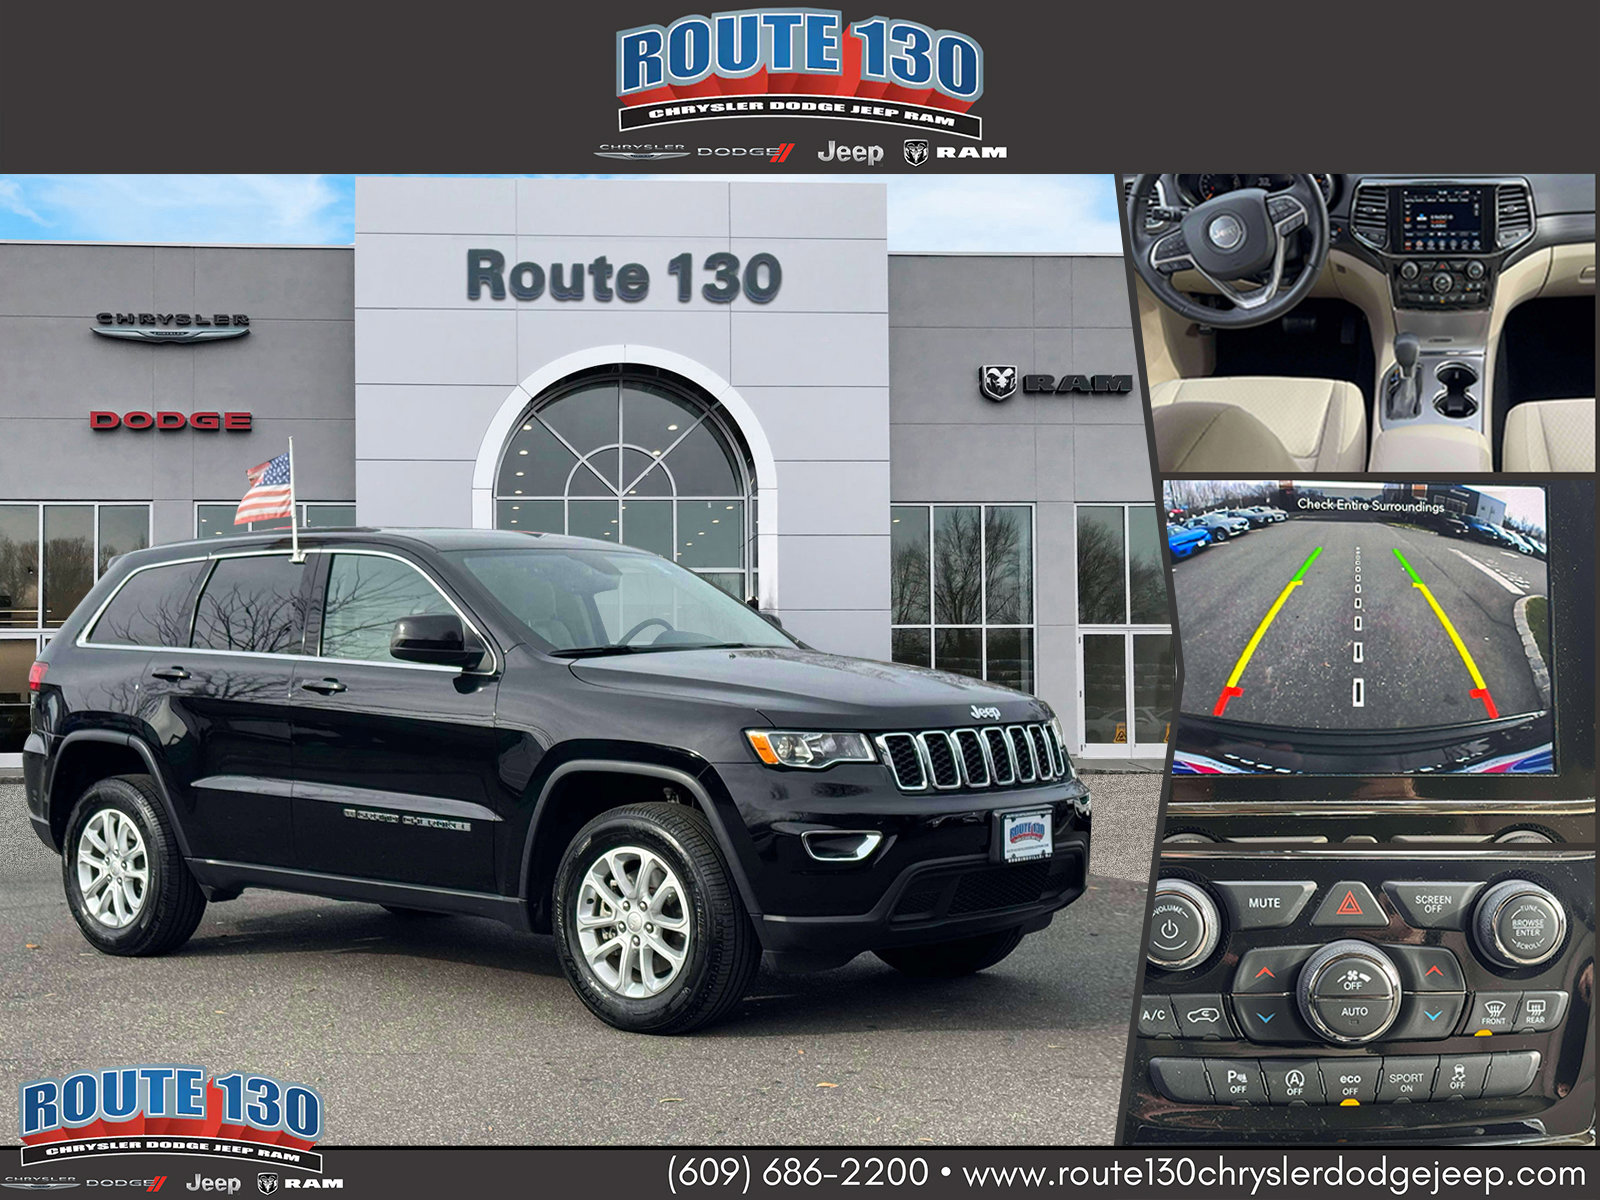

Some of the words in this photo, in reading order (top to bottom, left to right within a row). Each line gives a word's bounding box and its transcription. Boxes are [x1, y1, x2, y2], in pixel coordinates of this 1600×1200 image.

[466, 247, 651, 303] Route
[667, 251, 783, 305] 130
[96, 312, 250, 326] CHRYSLER
[1022, 374, 1133, 395] RAM
[89, 410, 252, 432] DODGE
[1297, 498, 1334, 510] Check
[1336, 499, 1370, 510] Entire
[1371, 500, 1445, 515] Surroundings
[970, 704, 1001, 720] Jeep
[1248, 898, 1281, 909] MUTE
[1415, 895, 1452, 905] SCREEN
[1154, 905, 1183, 915] VOLUME
[1424, 905, 1443, 914] OFF
[1512, 918, 1544, 927] BROWSE
[1515, 928, 1541, 936] ENTER
[1516, 941, 1541, 950] SCROLL
[1343, 981, 1363, 990] OFF
[1142, 1009, 1166, 1021] A/C
[1341, 1007, 1368, 1016] AUTO
[1481, 1017, 1506, 1025] FRONT
[1526, 1016, 1546, 1024] REAR
[1339, 1075, 1361, 1084] eco
[1389, 1073, 1424, 1083] SPORT
[1230, 1085, 1247, 1094] OFF
[1400, 1084, 1413, 1092] ON
[1449, 1081, 1466, 1090] OFF
[1286, 1087, 1303, 1096] OFF
[1342, 1087, 1359, 1096] OFF
